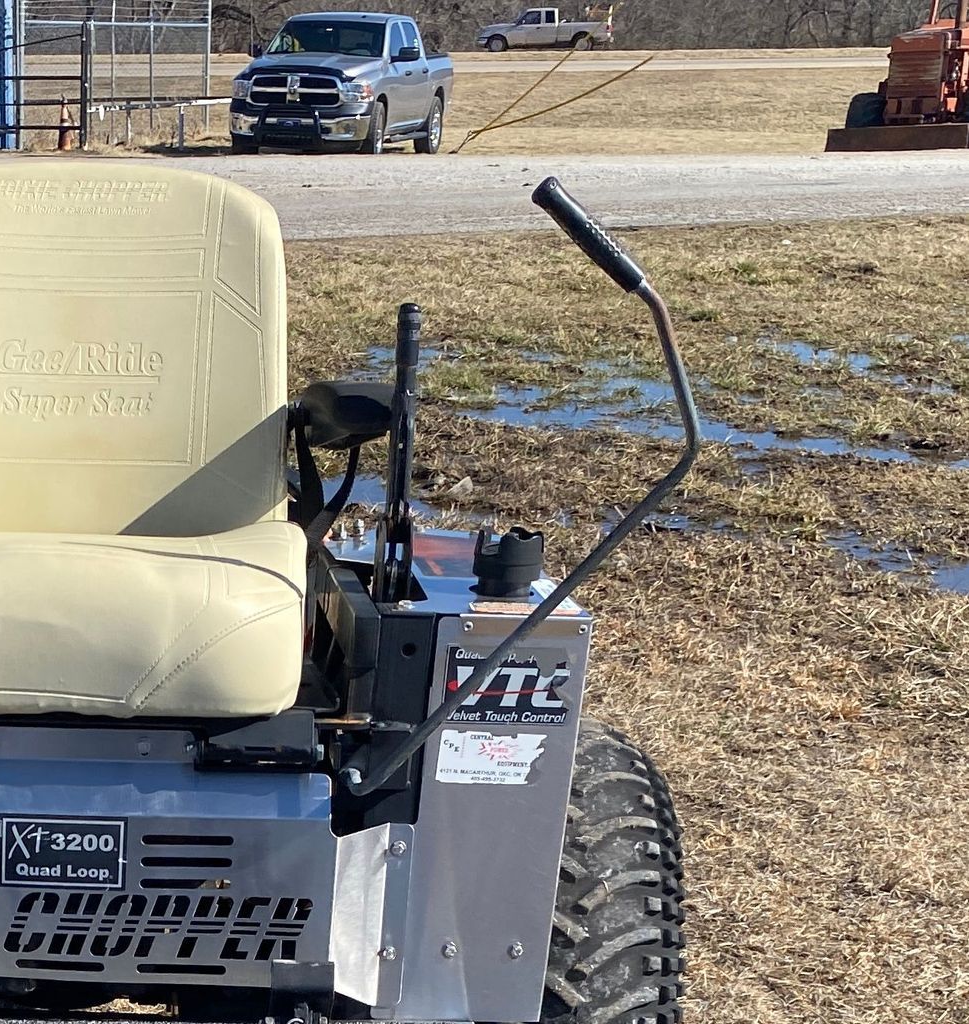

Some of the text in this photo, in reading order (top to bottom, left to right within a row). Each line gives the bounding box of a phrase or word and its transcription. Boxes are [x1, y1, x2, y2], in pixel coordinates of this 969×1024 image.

[1, 387, 154, 421] Super Seat
[485, 710, 518, 722] Touch
[521, 712, 565, 723] Control
[16, 863, 110, 881] Quad Loop
[2, 891, 314, 961] CHOPPER
